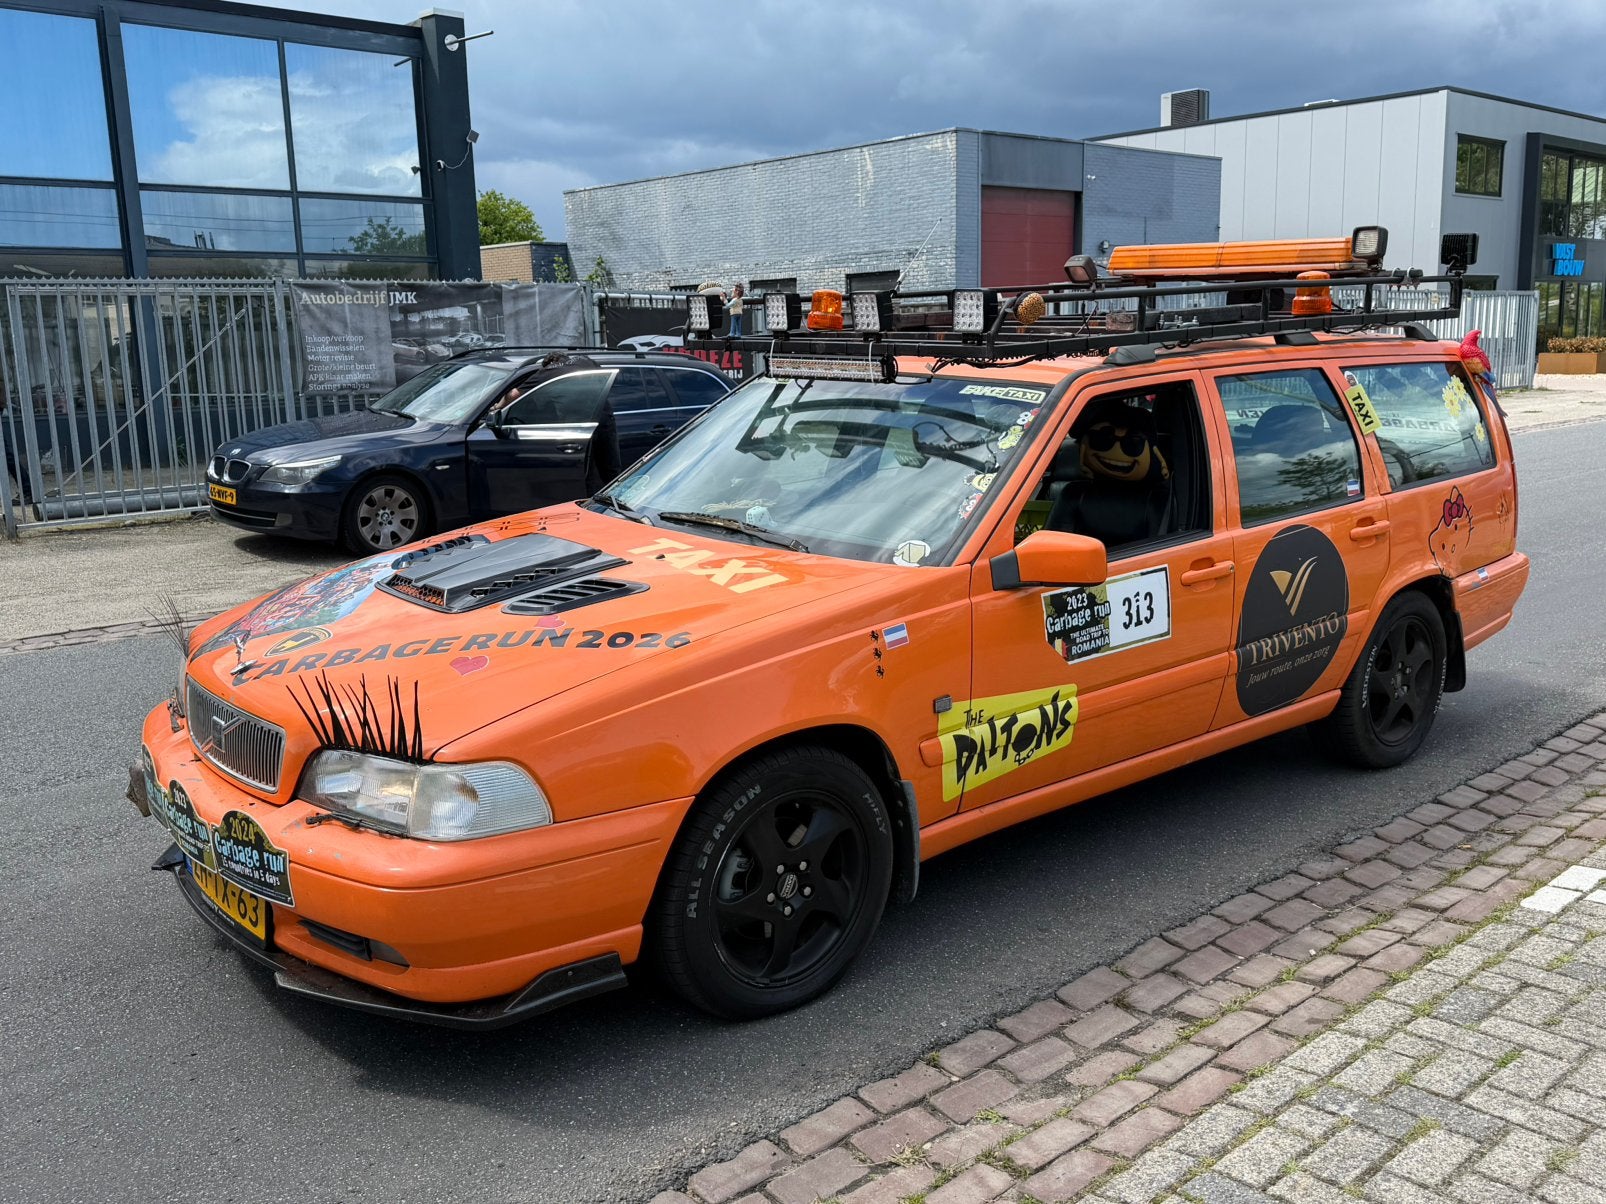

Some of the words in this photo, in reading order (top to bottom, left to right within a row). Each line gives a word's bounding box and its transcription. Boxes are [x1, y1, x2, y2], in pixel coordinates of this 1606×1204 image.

[1555, 260, 1585, 276] BOUW
[301, 290, 387, 307] Autobedrijf
[389, 292, 417, 306] JMK
[305, 334, 364, 344] Inkoop/verkoop
[306, 344, 365, 352] Bandenwisselen
[308, 373, 324, 381] APK
[346, 372, 371, 380] maken
[963, 385, 1004, 396] FAKE
[1008, 390, 1040, 401] TAXI
[1351, 391, 1375, 427] TAXI
[627, 537, 790, 594] TAXI
[1067, 592, 1088, 610] 2023
[1122, 590, 1154, 630] 313
[1046, 607, 1092, 634] Carbage
[1093, 601, 1111, 619] run
[575, 629, 693, 649] 2026
[1070, 631, 1081, 640] THE
[1081, 623, 1106, 637] ULTIMATE
[1075, 634, 1091, 644] ROAD
[1091, 631, 1103, 641] TRIP
[1246, 611, 1339, 666] TRIVENTO
[1071, 636, 1110, 656] ROMANIA
[1246, 670, 1270, 688] Jouw
[1270, 661, 1293, 676] route,
[1294, 653, 1313, 666] onze
[1313, 645, 1331, 658] zorg
[963, 708, 985, 729] THE
[952, 689, 1073, 785] DALTONS
[229, 816, 256, 844] 2024
[214, 833, 260, 868] Carbage
[263, 851, 285, 873] run
[686, 877, 703, 919] ALL
[696, 783, 763, 871] SEASON
[265, 873, 281, 886] days
